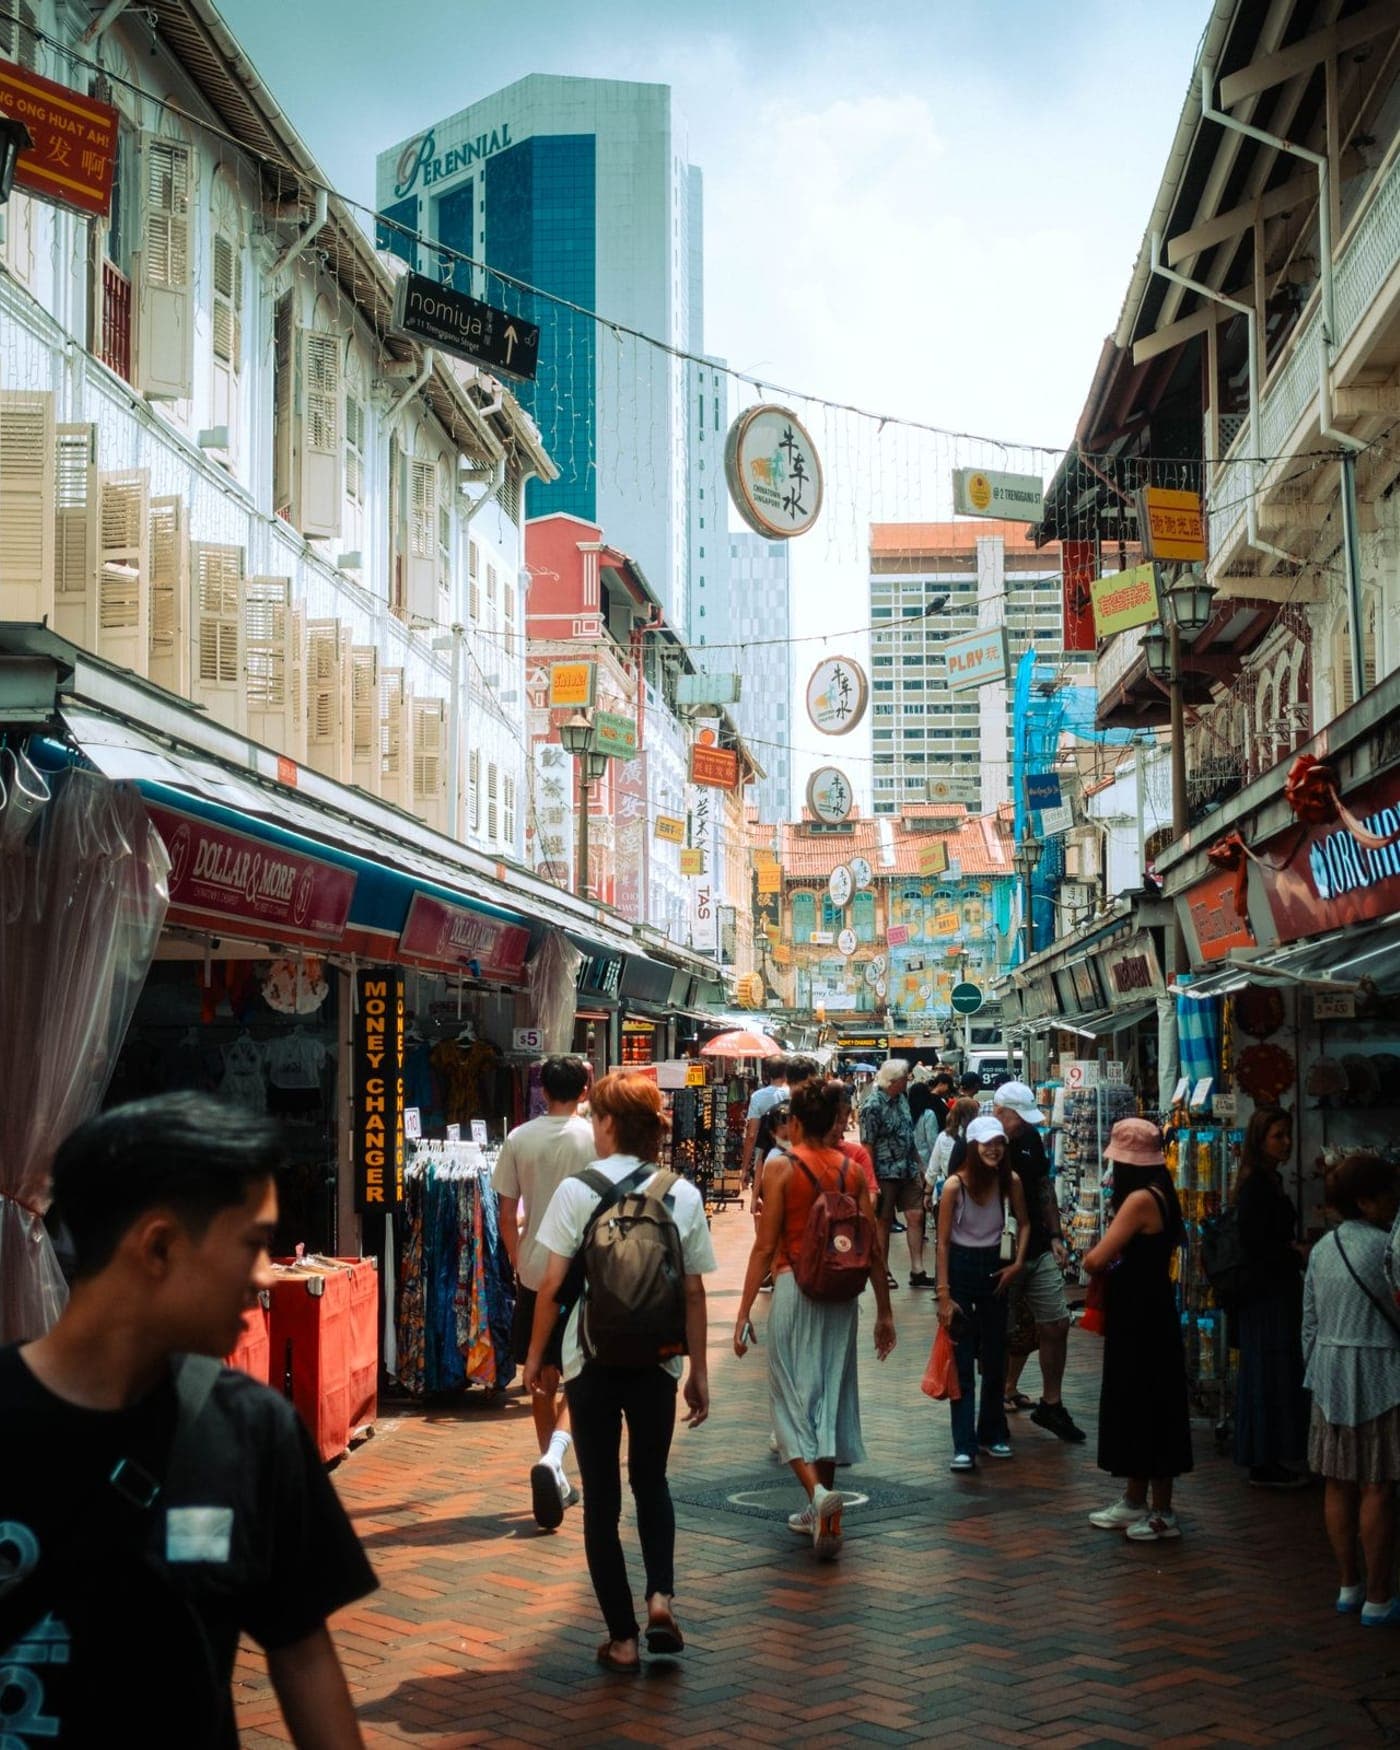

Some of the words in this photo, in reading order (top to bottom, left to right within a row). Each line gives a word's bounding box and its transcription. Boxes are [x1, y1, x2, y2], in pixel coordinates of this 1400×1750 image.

[17, 99, 46, 121] ONG
[50, 112, 85, 137] HUAT
[87, 128, 111, 149] AH!
[410, 291, 482, 336] nomiya
[948, 648, 984, 673] PLAY
[193, 838, 250, 887] DOLLAR
[245, 852, 261, 902] &
[259, 859, 297, 900] MORE
[697, 884, 710, 921] TAS
[365, 981, 387, 1069] MONEY
[519, 1032, 538, 1046] $5
[365, 1078, 386, 1202] CHANGER
[396, 1077, 404, 1201] CHANGER
